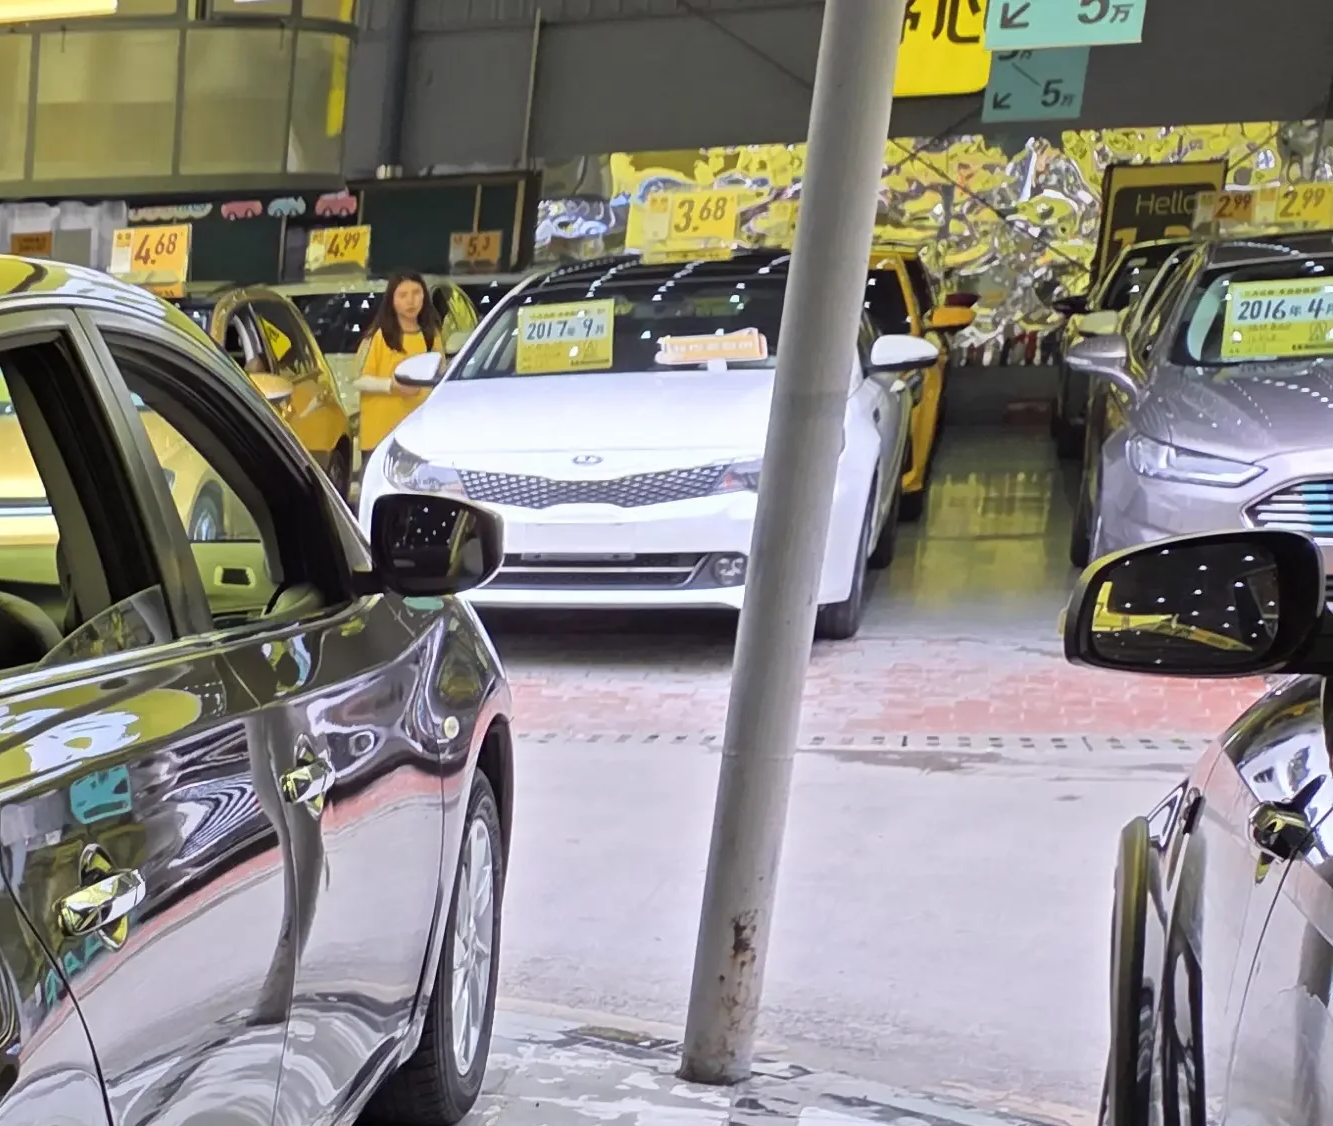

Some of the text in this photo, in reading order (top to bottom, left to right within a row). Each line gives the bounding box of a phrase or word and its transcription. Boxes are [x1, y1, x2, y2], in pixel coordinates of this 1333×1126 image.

[674, 196, 728, 233] 3.68
[1214, 194, 1252, 219] 2.99
[1280, 186, 1326, 218] 2.99
[134, 232, 178, 265] 4.68
[327, 231, 361, 258] 4.99
